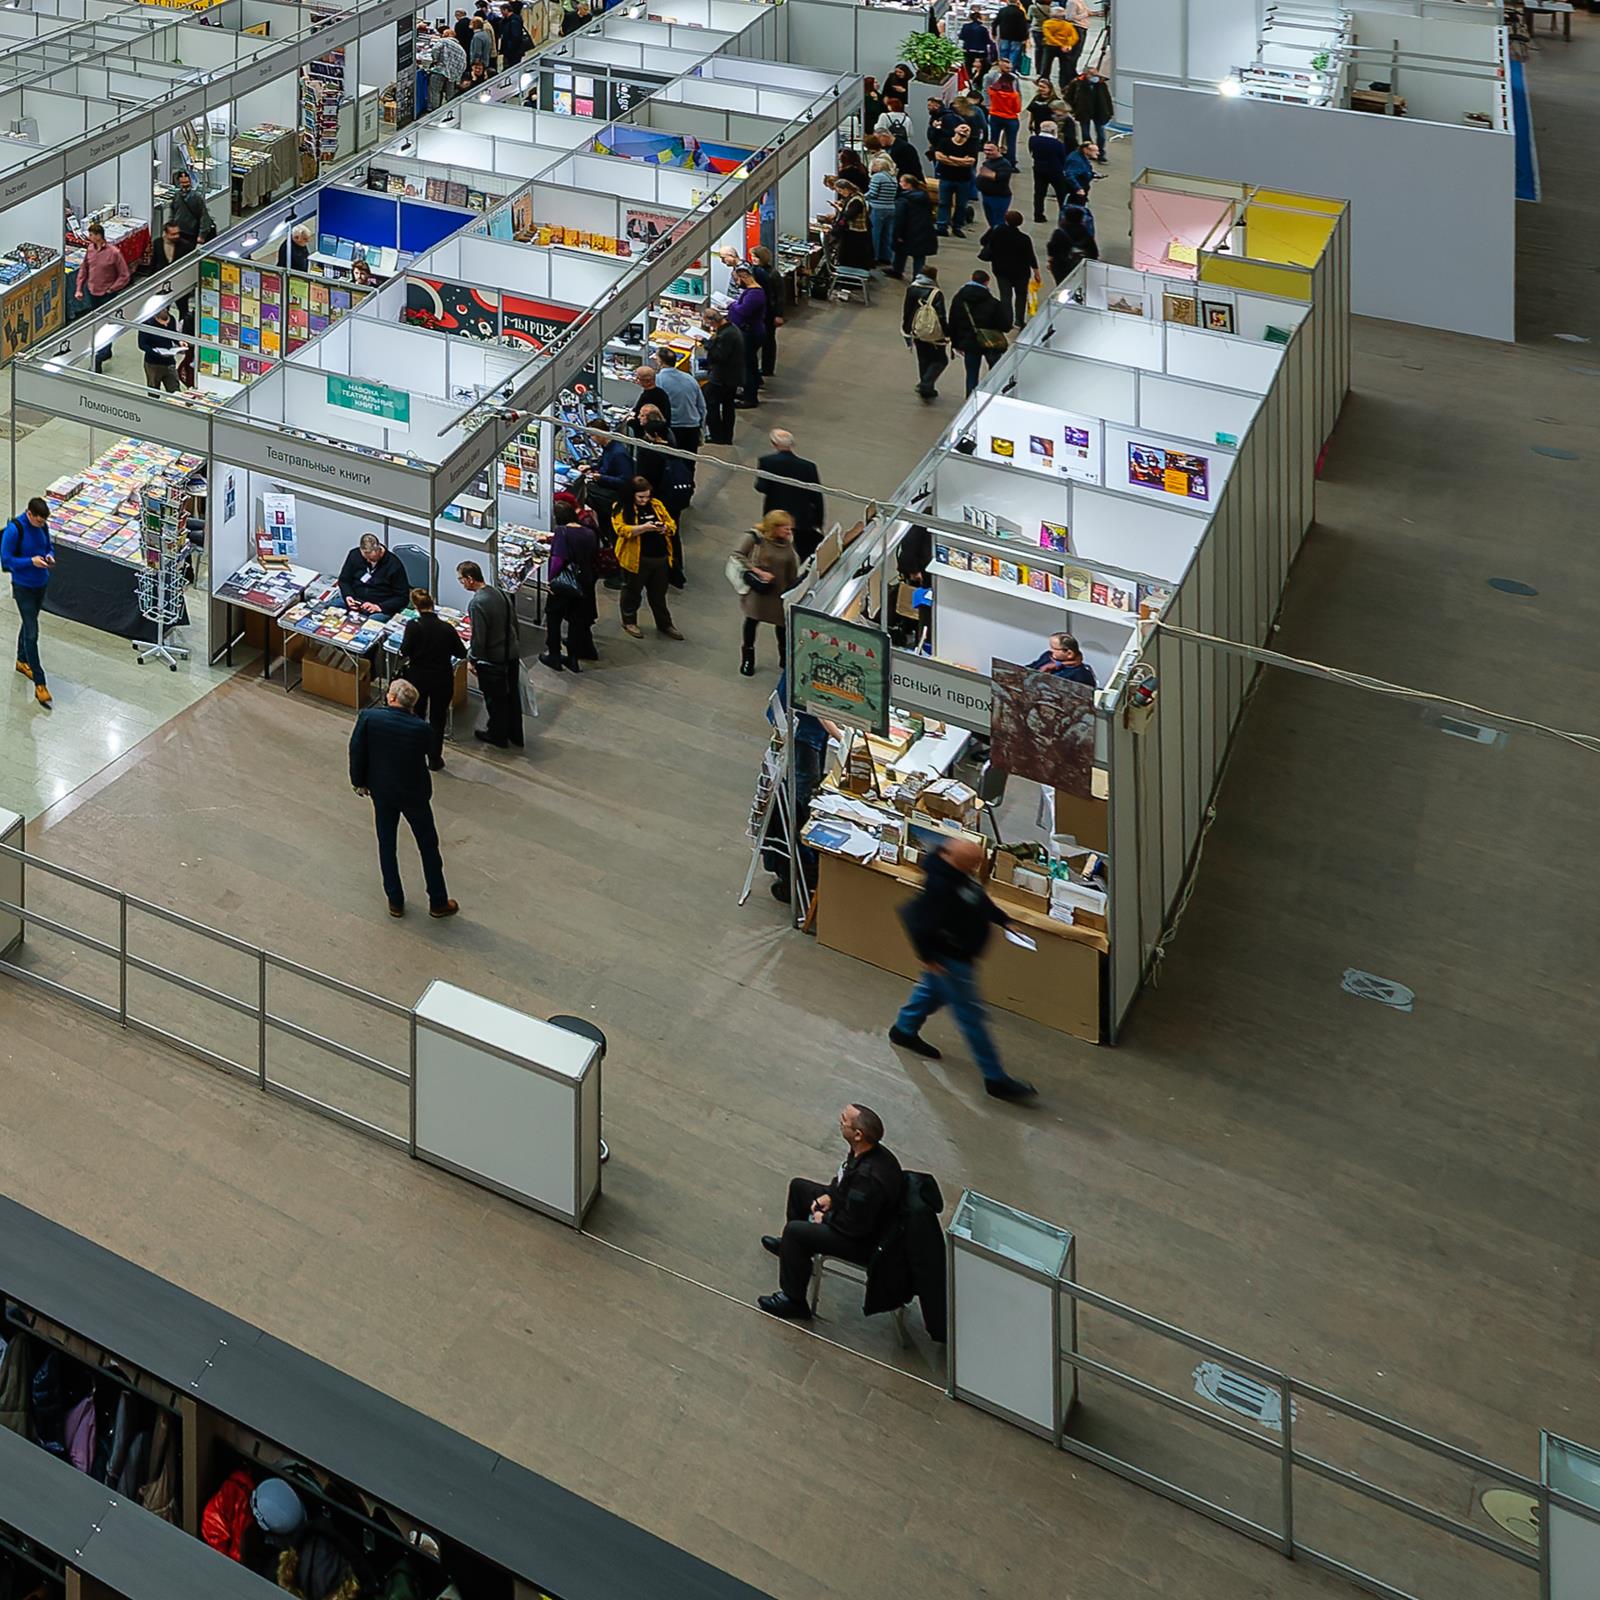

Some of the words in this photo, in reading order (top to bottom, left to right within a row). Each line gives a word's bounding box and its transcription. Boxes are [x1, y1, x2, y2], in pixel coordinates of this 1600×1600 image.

[79, 395, 141, 423] Ломоносовъ
[341, 390, 394, 409] ТЕАТРАЛЬНЫЕ
[354, 399, 381, 412] КНИГИ
[265, 446, 336, 475] Театральные
[339, 469, 371, 485] книги
[890, 673, 942, 697] асный
